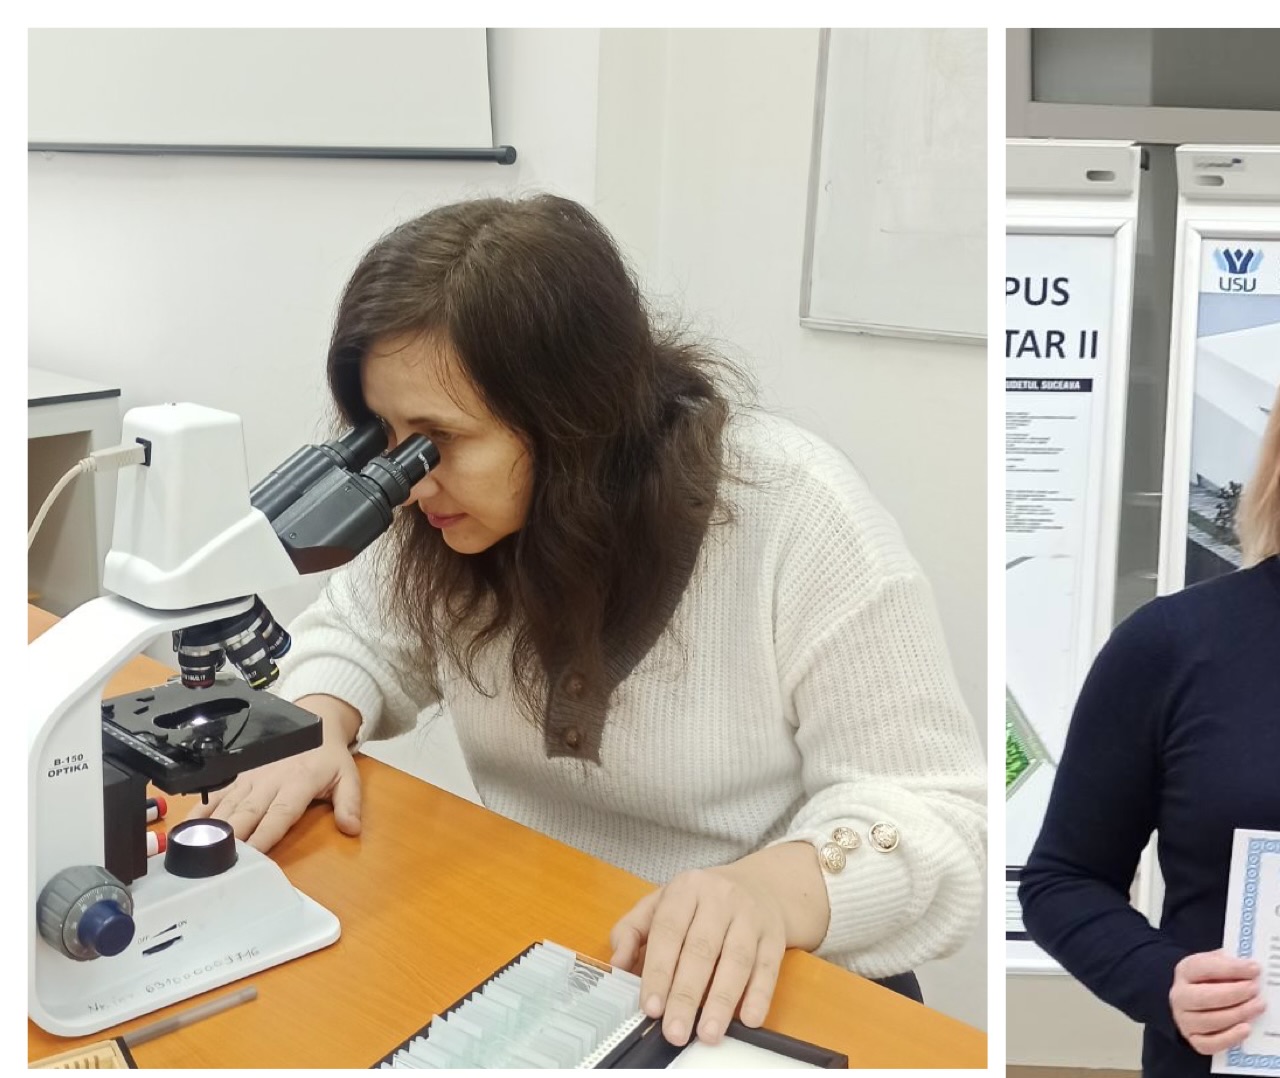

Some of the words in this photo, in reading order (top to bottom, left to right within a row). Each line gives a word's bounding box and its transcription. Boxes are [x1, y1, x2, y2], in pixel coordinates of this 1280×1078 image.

[1219, 277, 1257, 293] USU
[1079, 330, 1098, 360] II
[47, 762, 89, 778] OPTIKA
